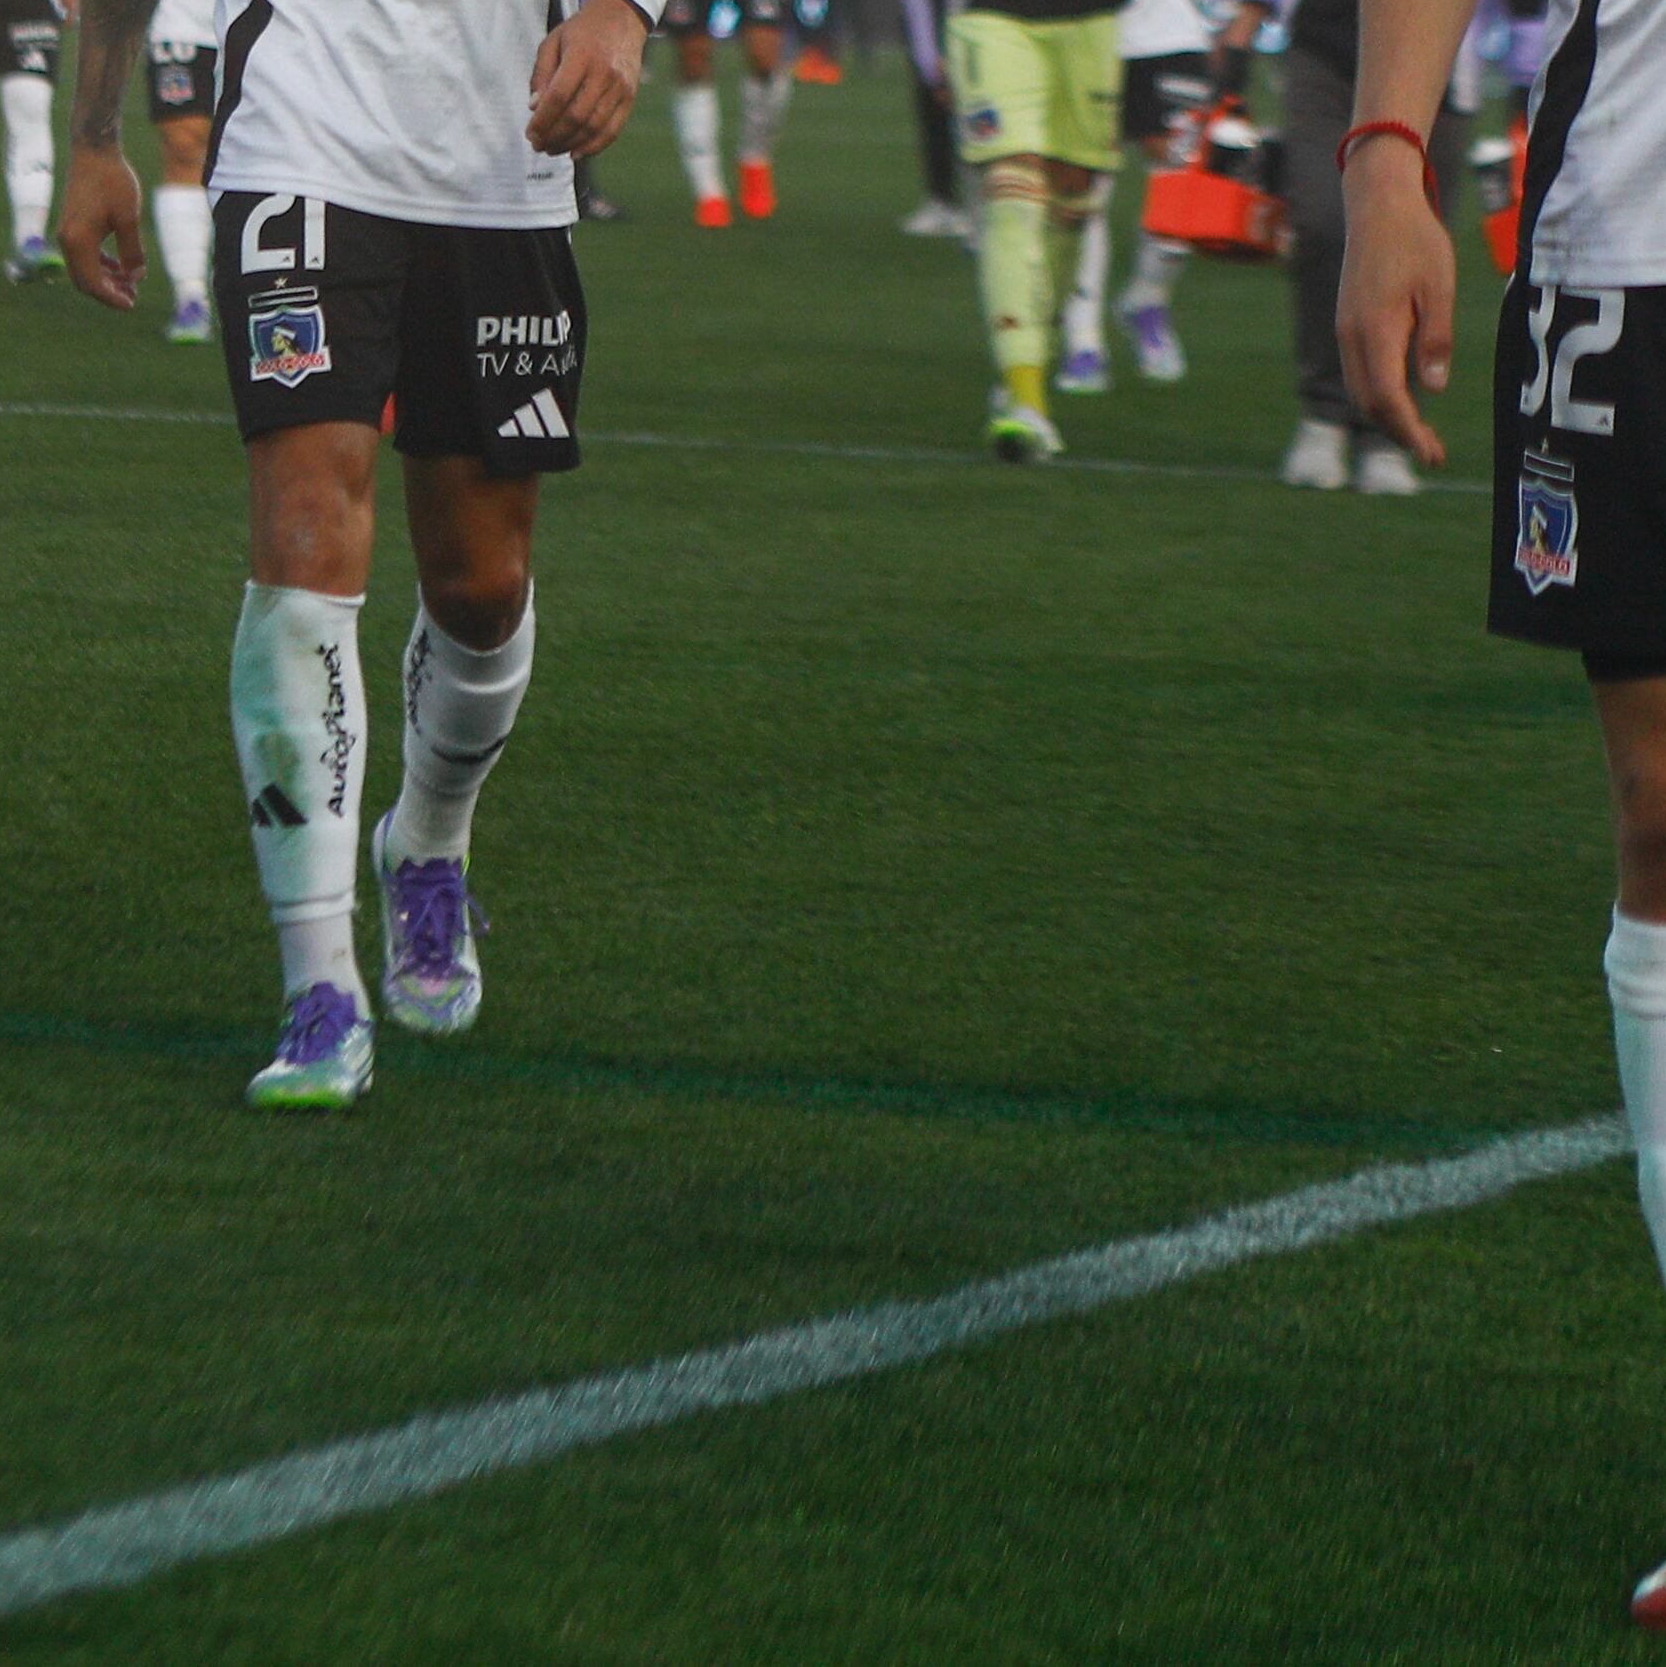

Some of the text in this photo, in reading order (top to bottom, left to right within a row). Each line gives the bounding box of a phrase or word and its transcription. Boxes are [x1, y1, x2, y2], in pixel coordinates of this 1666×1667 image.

[241, 192, 326, 275] 21
[476, 352, 510, 377] TV
[515, 352, 533, 376] &
[1519, 285, 1625, 436] 32
